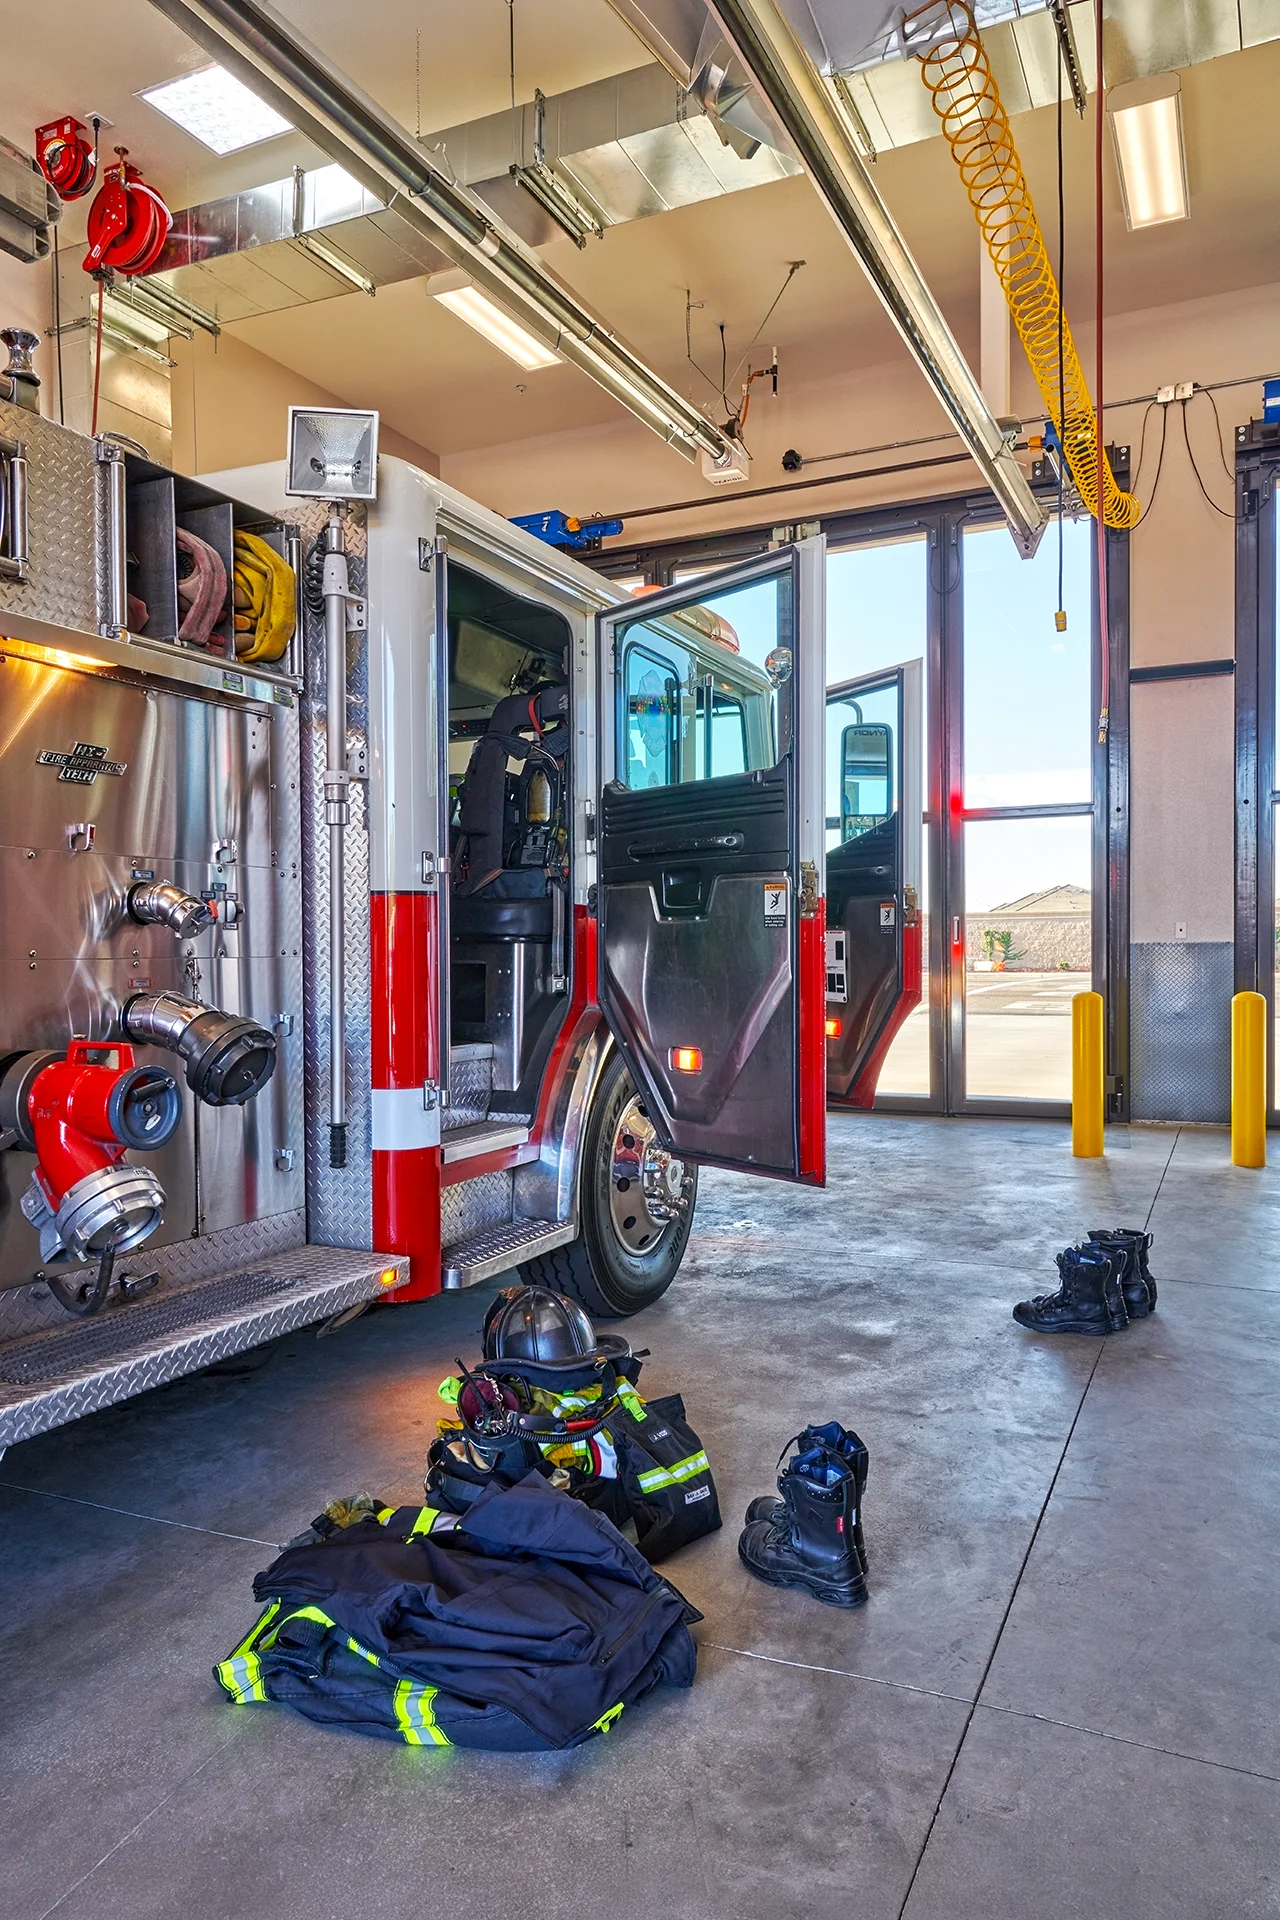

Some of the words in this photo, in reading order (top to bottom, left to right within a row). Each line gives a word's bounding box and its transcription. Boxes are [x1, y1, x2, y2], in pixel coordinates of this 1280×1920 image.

[45, 752, 68, 765] FIRE
[69, 757, 122, 773] APPARATUS
[66, 768, 95, 781] TECH
